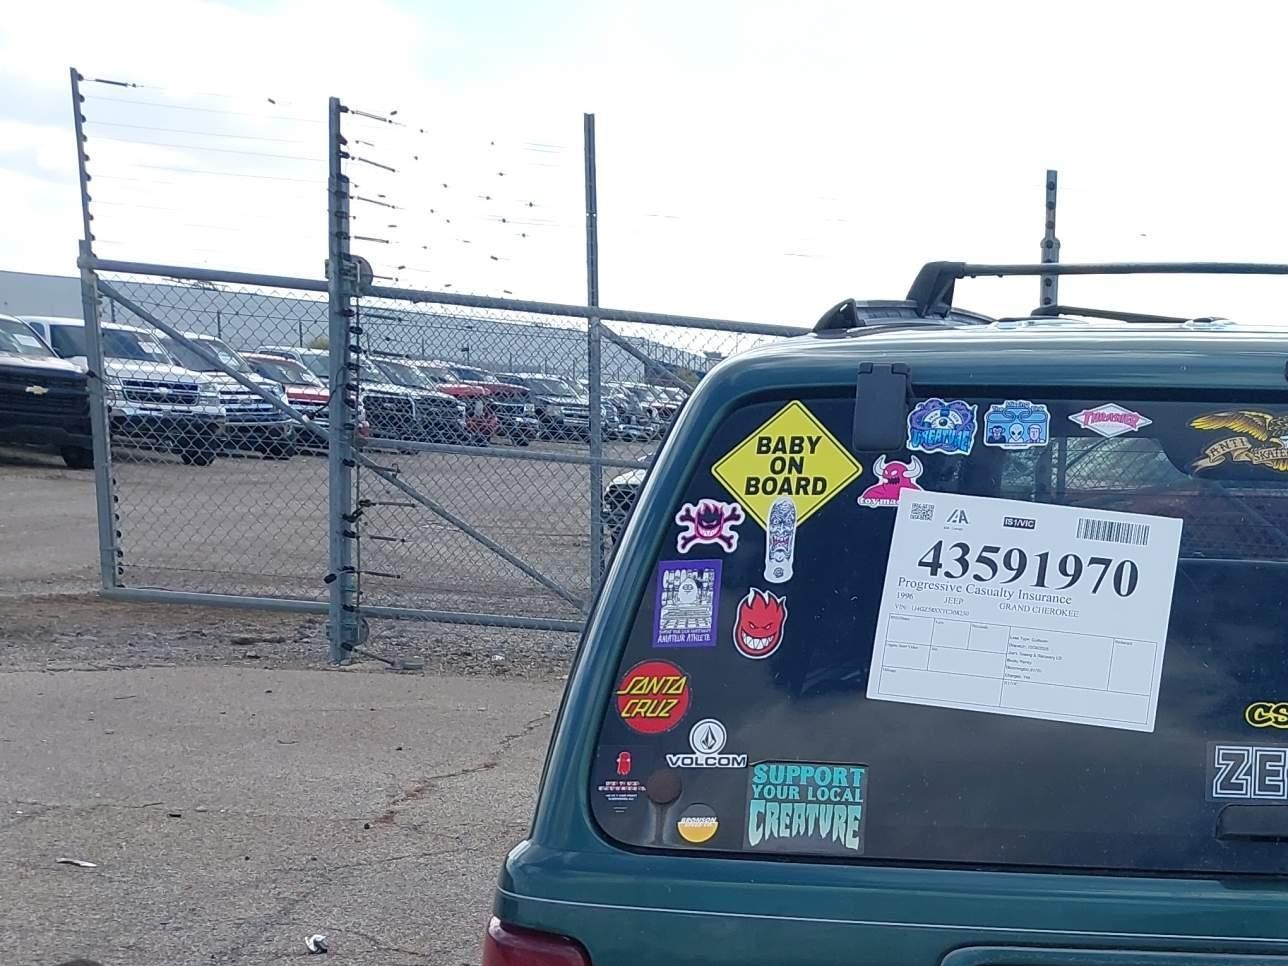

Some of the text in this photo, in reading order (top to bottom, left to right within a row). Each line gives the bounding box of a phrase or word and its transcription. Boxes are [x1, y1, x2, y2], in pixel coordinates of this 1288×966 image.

[756, 436, 822, 455] BABY
[1210, 438, 1246, 457] ANTI
[770, 457, 804, 475] ON
[744, 477, 827, 496] BOARD
[917, 539, 1139, 598] 43591970
[897, 576, 1072, 605] Progressive Casualty Insurance
[896, 591, 1080, 618] 1996 JEEP GRAND CHEROKEE
[616, 676, 687, 695] SANTA
[621, 699, 679, 718] CRUZ
[666, 754, 748, 768] VOLCOM
[752, 764, 865, 787] SUPPORT
[752, 784, 863, 803] YOUR LOCAL
[749, 799, 862, 850] CREATURE
